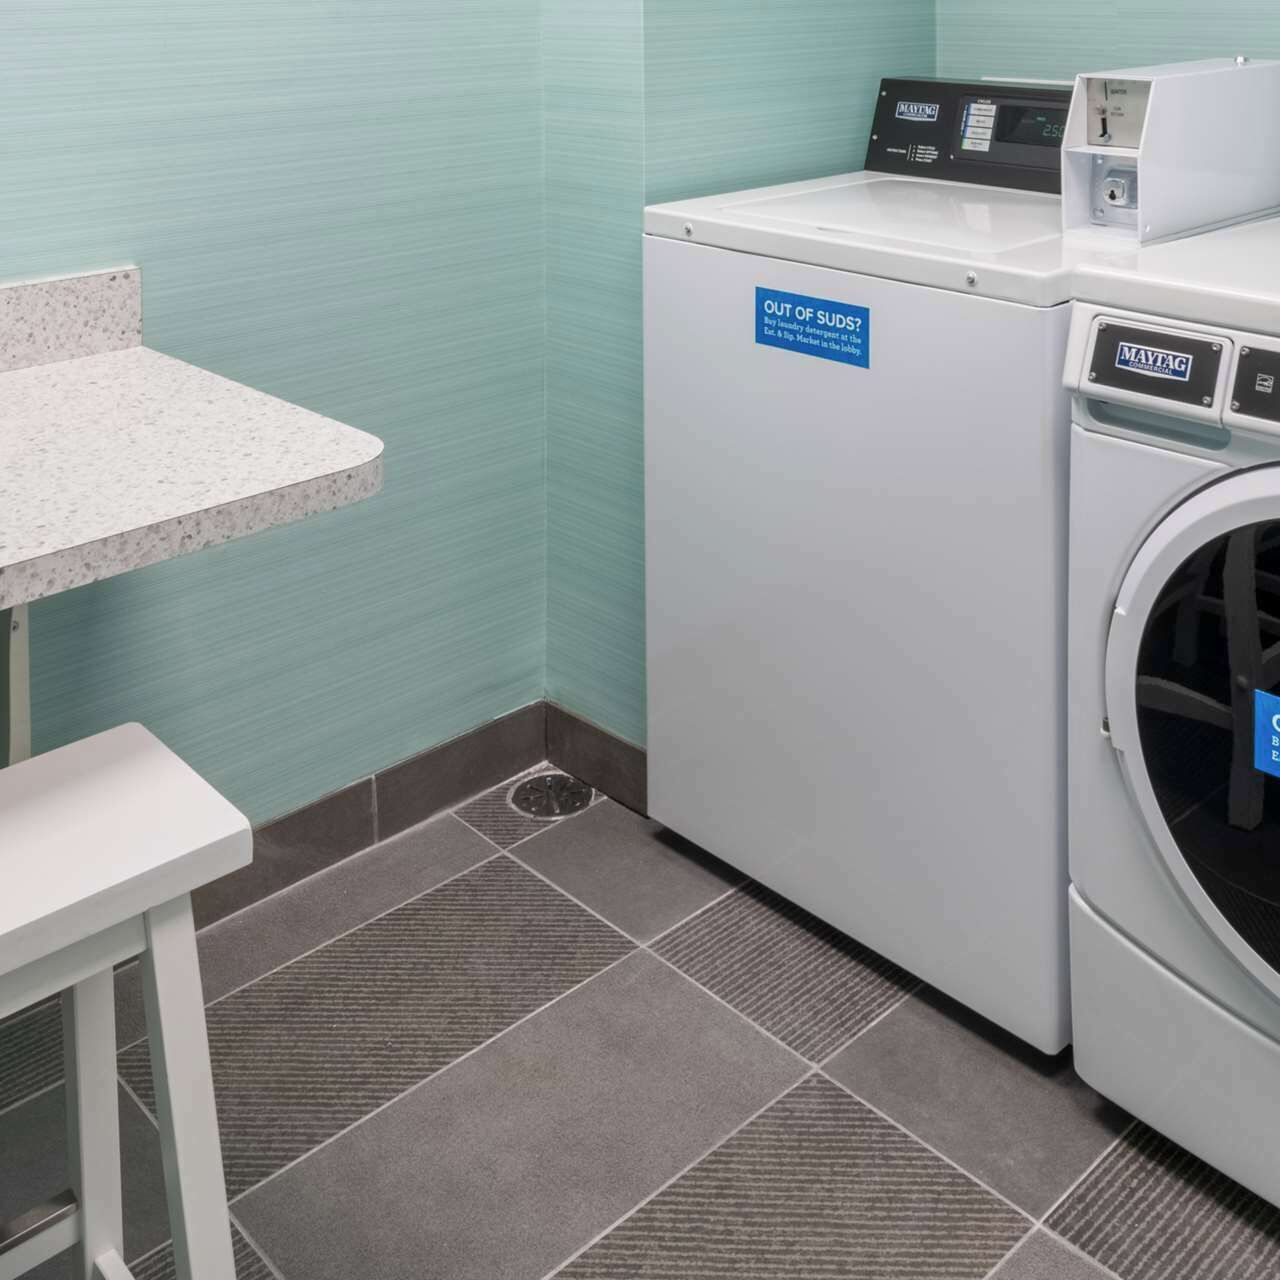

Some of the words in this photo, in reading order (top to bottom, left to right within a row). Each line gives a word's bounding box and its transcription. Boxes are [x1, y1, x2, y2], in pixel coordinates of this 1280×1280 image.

[899, 104, 936, 115] MAYTAG
[764, 300, 792, 317] OUT
[795, 306, 814, 321] OF
[817, 310, 862, 332] SUDS?
[763, 316, 777, 327] Buy
[777, 318, 805, 334] laundry
[805, 324, 840, 339] detergent
[849, 333, 861, 344] the
[796, 333, 820, 346] Market
[821, 339, 828, 347] in
[829, 341, 841, 351] the
[1120, 346, 1186, 371] MAYTAG
[1129, 360, 1173, 375] COMMERCIAL
